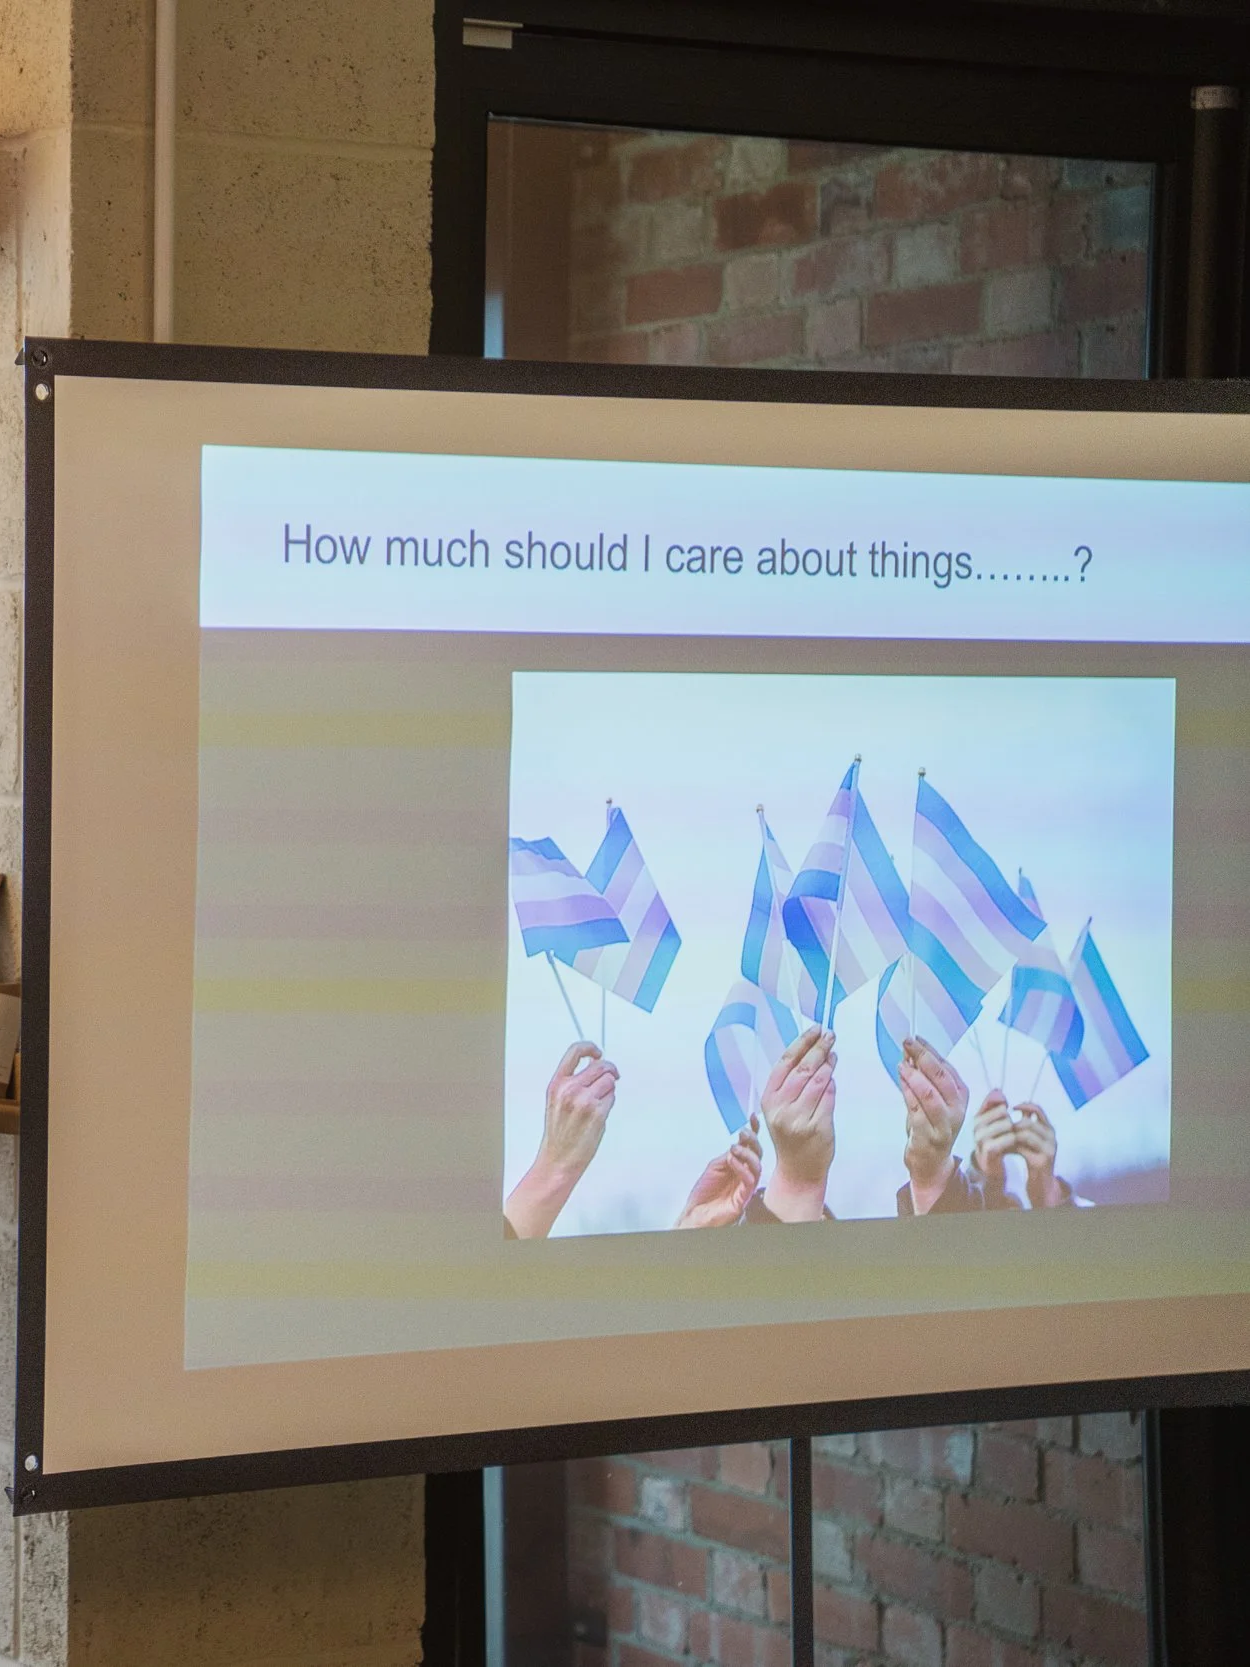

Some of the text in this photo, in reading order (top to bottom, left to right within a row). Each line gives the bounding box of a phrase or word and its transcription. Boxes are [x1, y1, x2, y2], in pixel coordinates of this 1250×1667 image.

[284, 522, 372, 566] How
[385, 528, 490, 569] much
[504, 530, 628, 573] should
[643, 533, 651, 573] I
[665, 543, 744, 575] care
[756, 537, 858, 577] about
